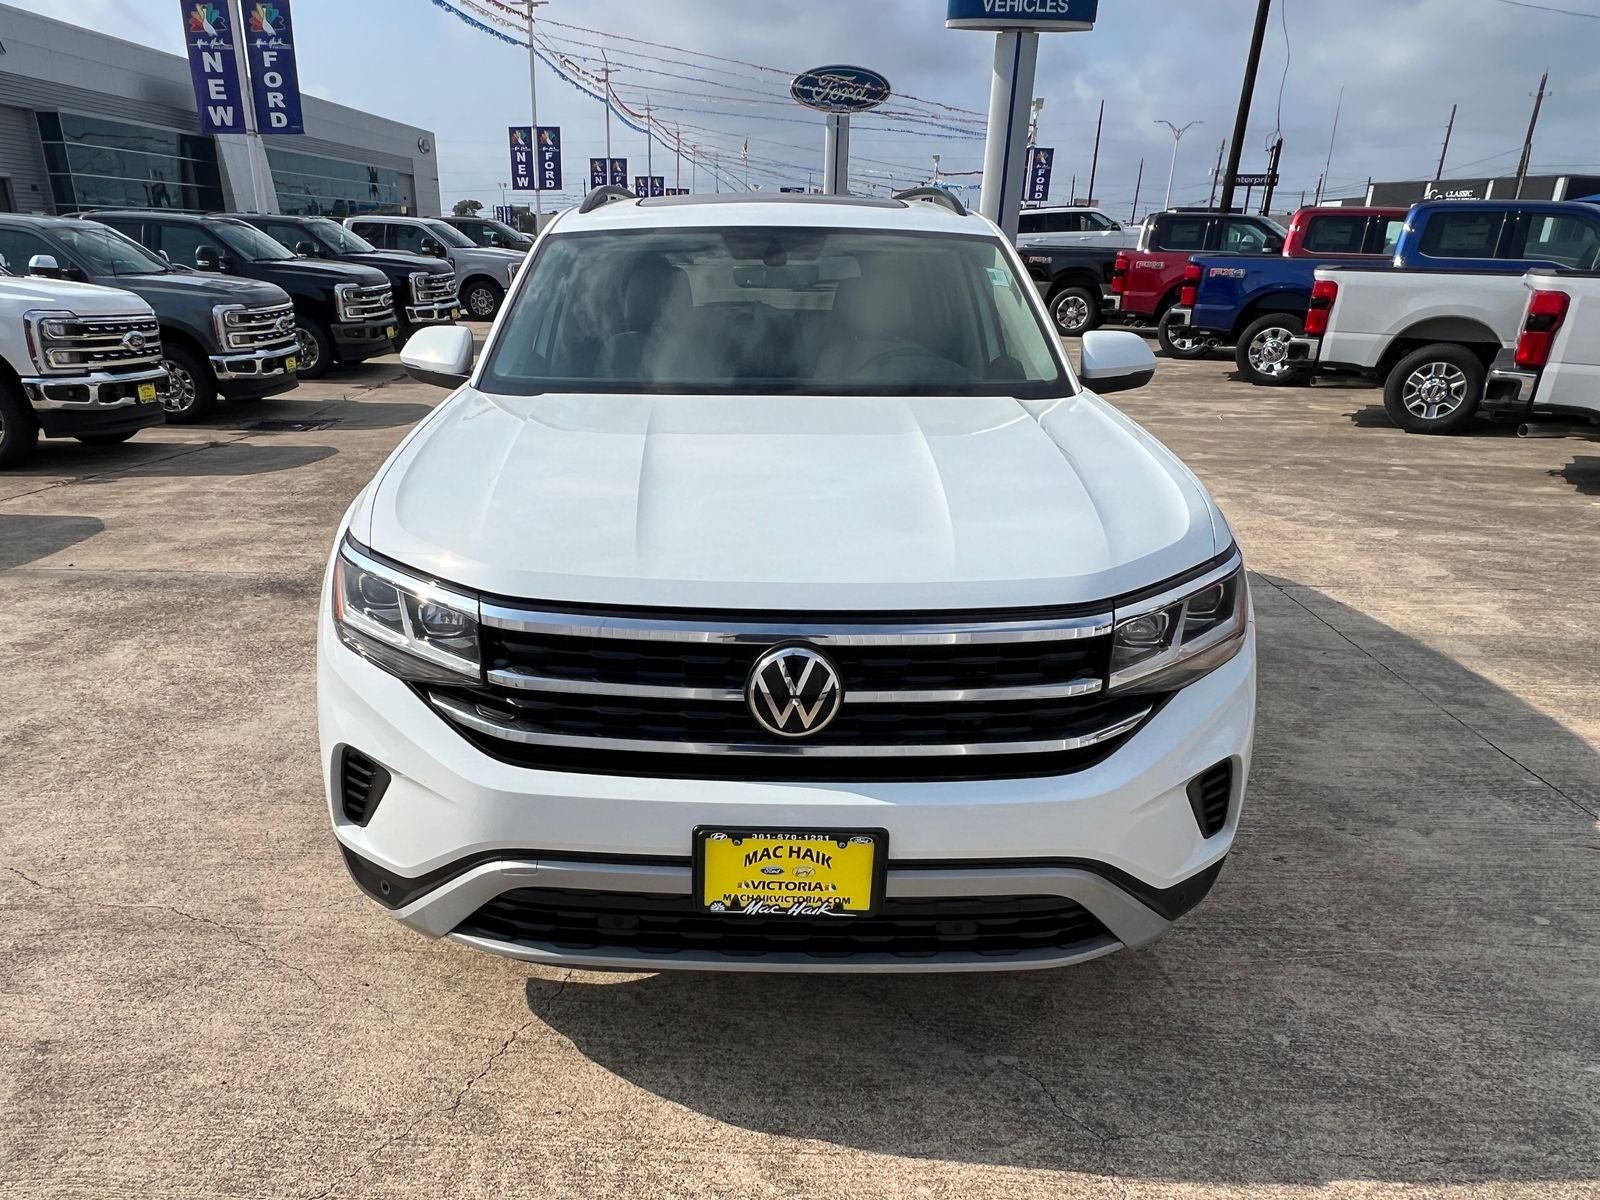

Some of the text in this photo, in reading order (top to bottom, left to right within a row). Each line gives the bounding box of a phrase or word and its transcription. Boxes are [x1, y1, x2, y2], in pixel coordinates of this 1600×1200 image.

[983, 0, 1069, 13] VEHICLES
[202, 51, 233, 127] NEW
[263, 51, 288, 128] FORD
[812, 74, 872, 101] Ford
[516, 152, 529, 187] NEW
[544, 152, 555, 188] FORD
[1034, 169, 1045, 199] FORD
[743, 845, 833, 870] MAC HAIK
[750, 880, 824, 892] VICTORIA
[744, 899, 832, 916] Mac Haik
